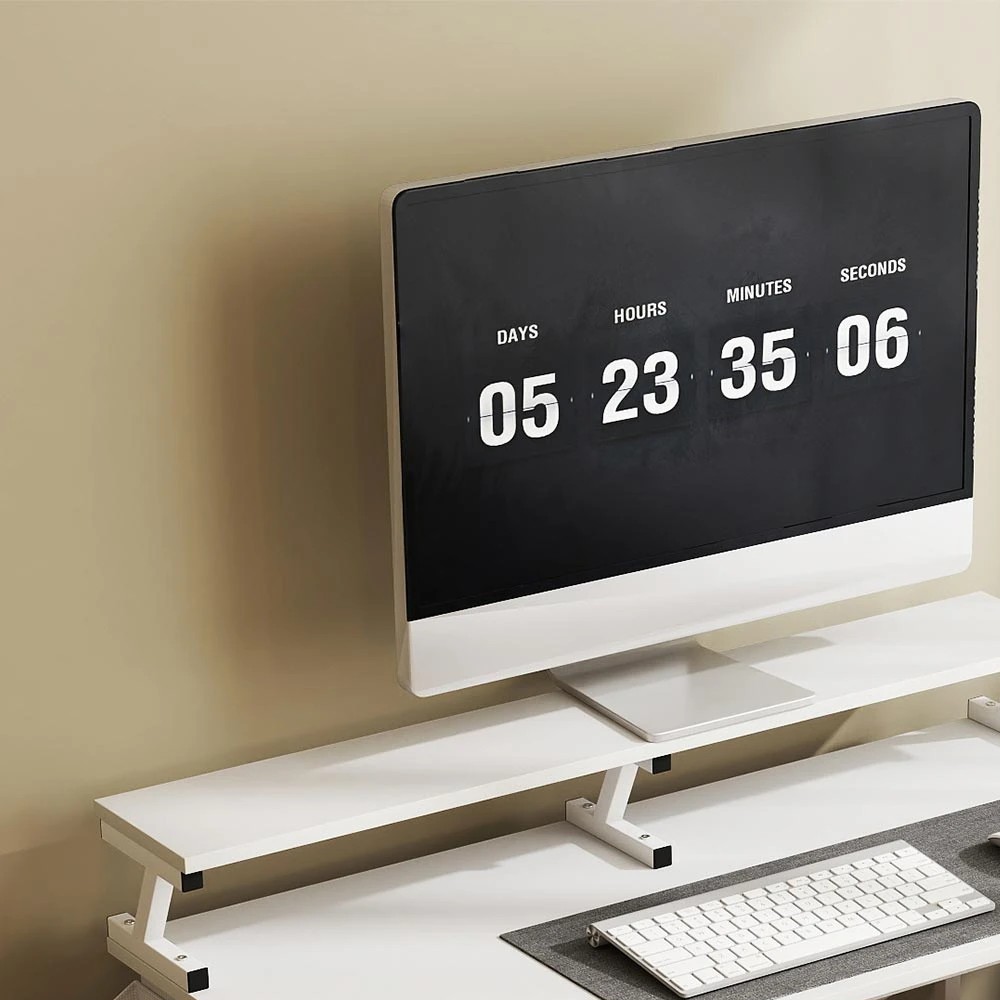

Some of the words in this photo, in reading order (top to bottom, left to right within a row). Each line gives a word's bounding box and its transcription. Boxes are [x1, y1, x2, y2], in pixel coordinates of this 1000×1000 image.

[497, 324, 539, 346] DAYS
[613, 301, 668, 324] HOURS
[726, 279, 792, 304] MINUTES
[840, 258, 907, 283] SECONDS
[479, 373, 560, 447] 05
[602, 351, 680, 424] 23
[720, 328, 796, 400] 35
[836, 307, 909, 378] 06
